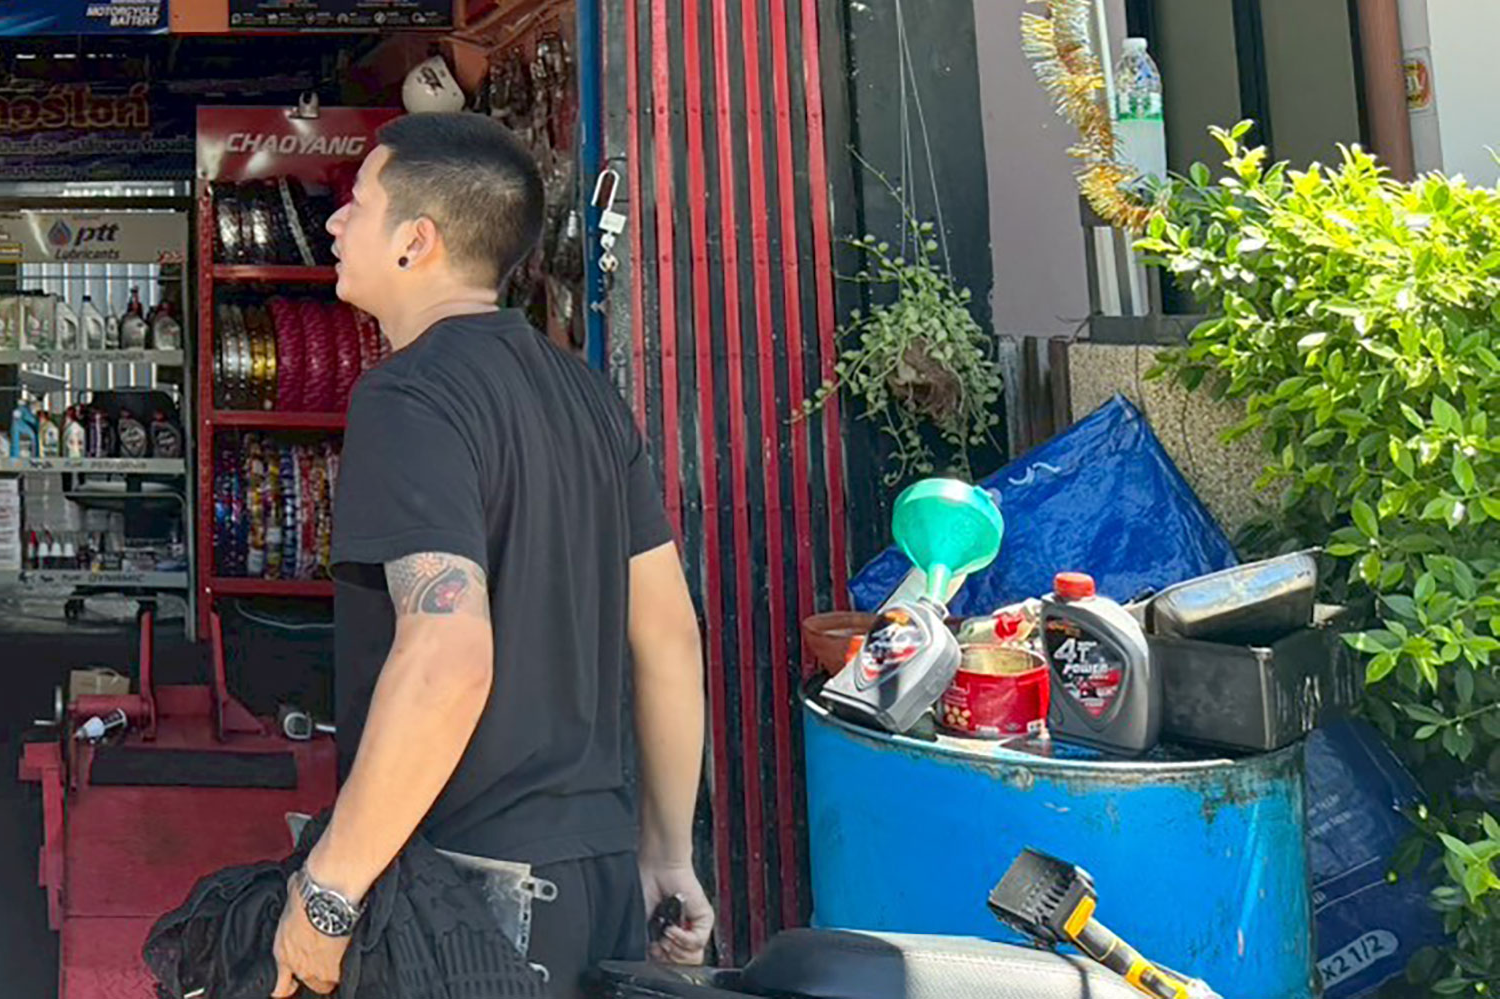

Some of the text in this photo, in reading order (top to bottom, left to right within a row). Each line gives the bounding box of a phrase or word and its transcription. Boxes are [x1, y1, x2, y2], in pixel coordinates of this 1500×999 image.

[86, 4, 160, 17] MOTORCYCLE
[110, 15, 160, 27] BATTERY
[226, 133, 368, 156] CHAOYANG
[76, 222, 120, 246] ptt
[55, 247, 120, 261] Lubricants
[1054, 637, 1098, 663] 4T
